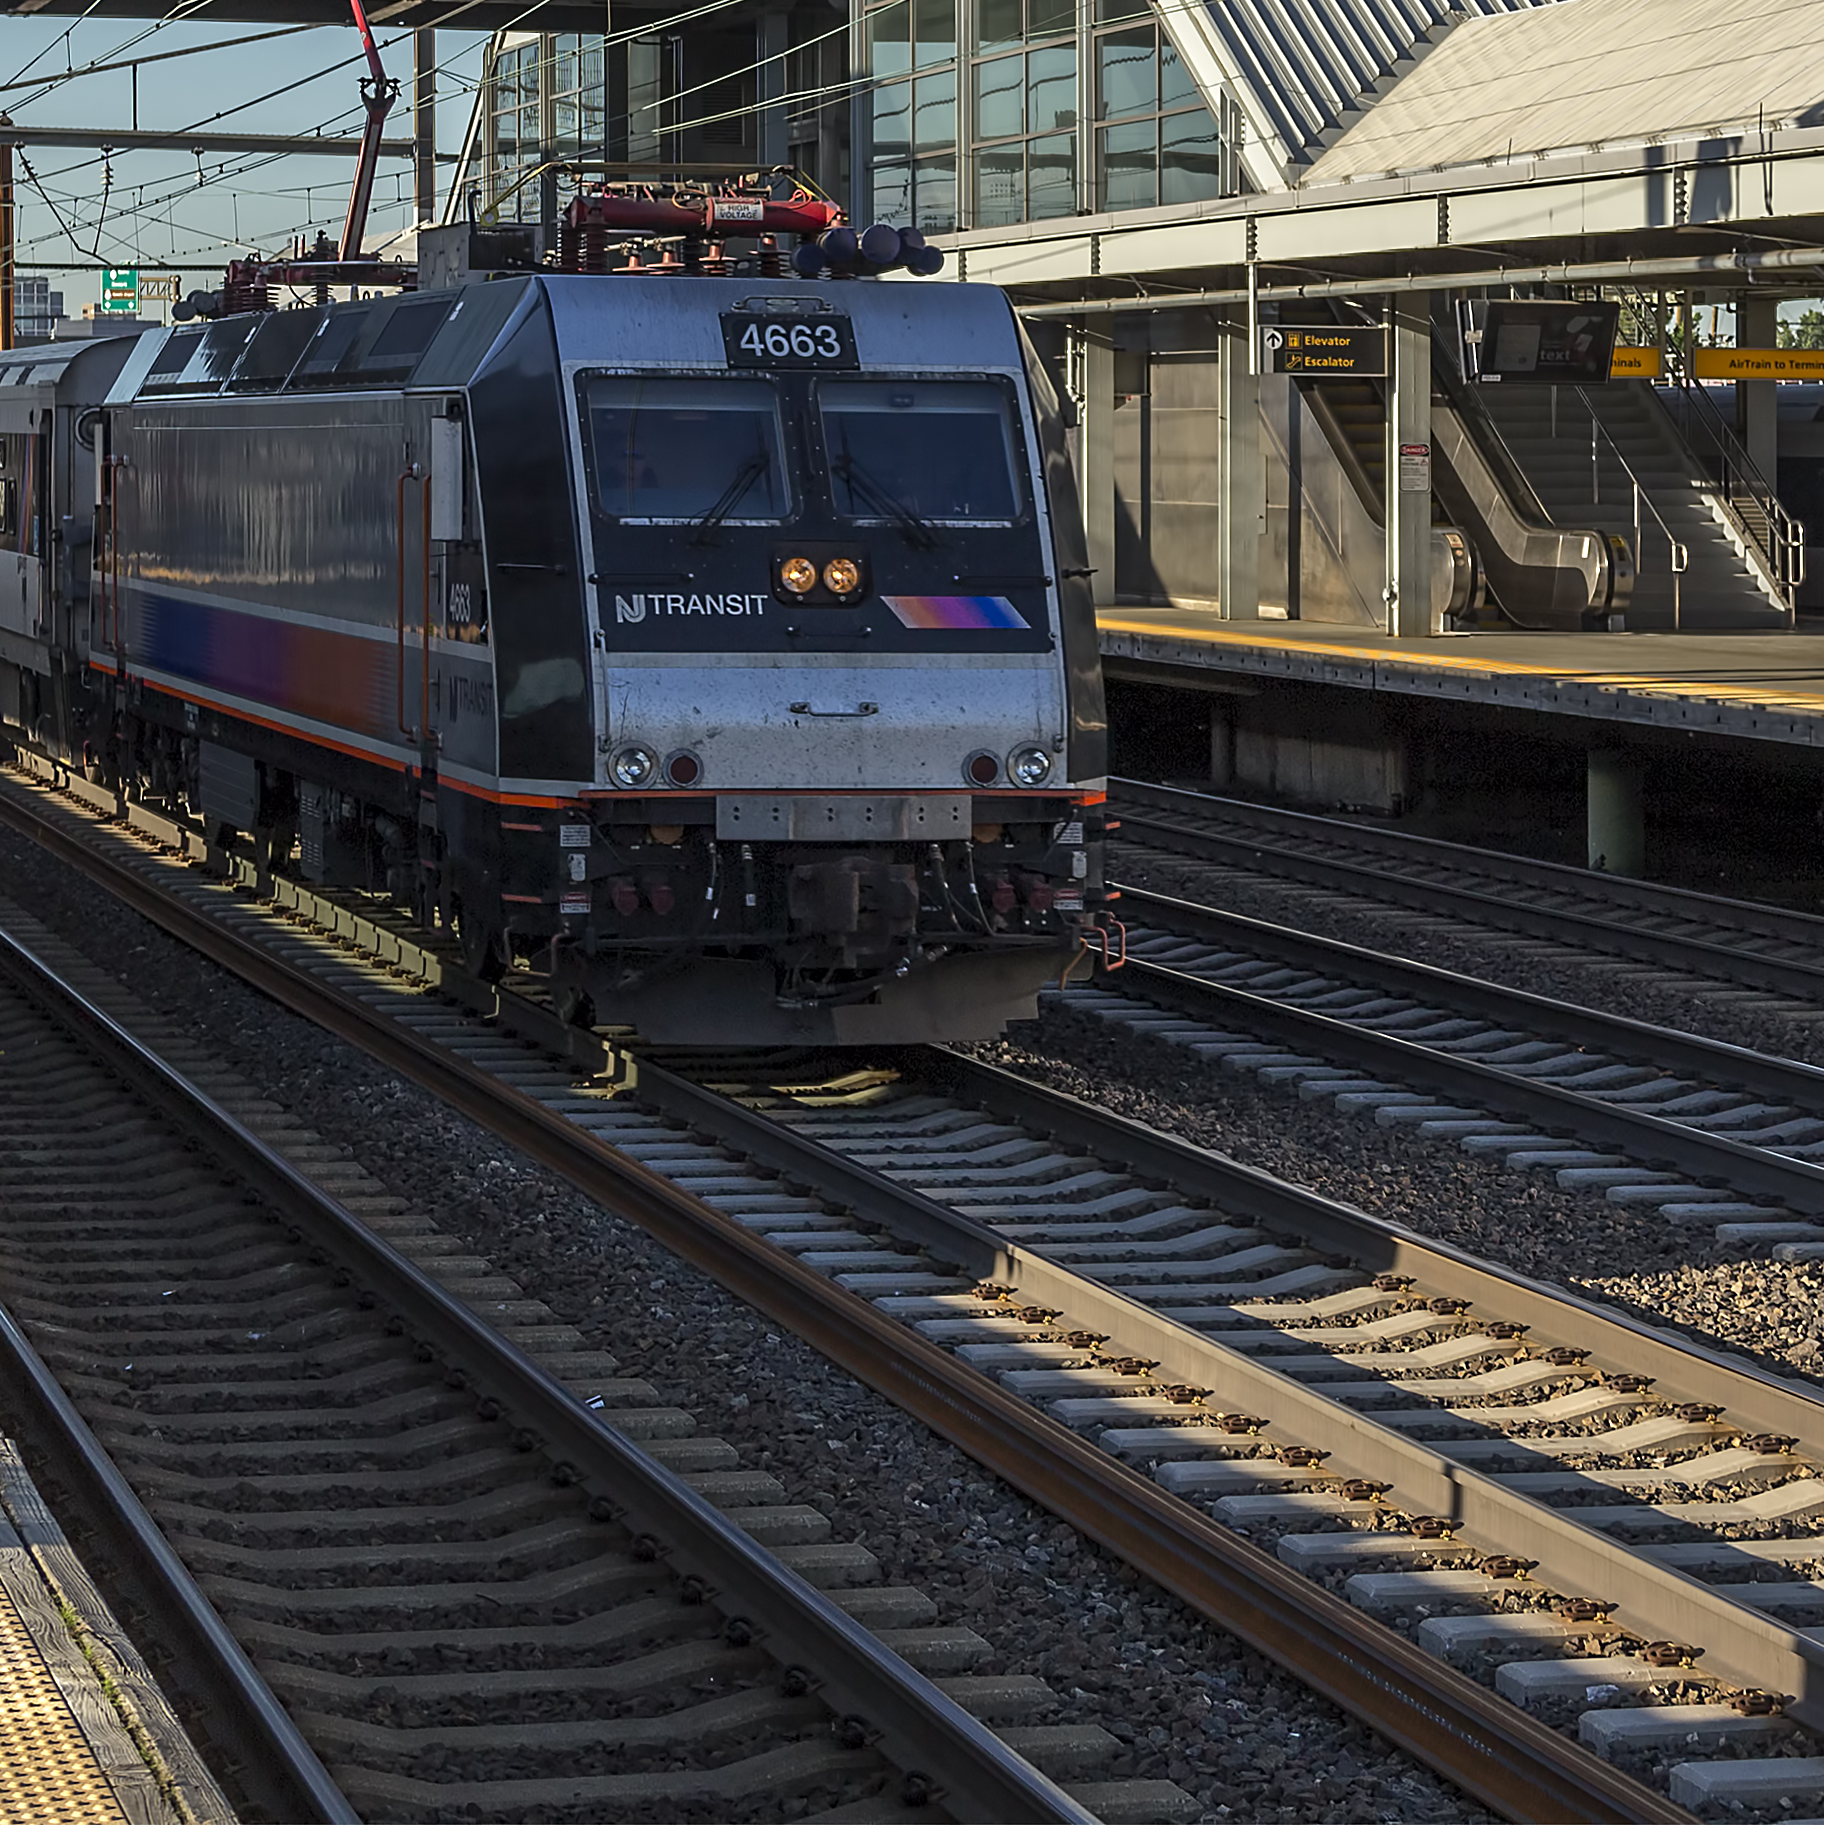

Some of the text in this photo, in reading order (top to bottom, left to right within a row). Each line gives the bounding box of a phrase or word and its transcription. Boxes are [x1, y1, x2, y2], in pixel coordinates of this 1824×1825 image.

[740, 323, 841, 357] 4663
[1304, 335, 1351, 346] Elevator
[1304, 356, 1355, 367] Escalator
[1540, 349, 1571, 362] text
[1729, 359, 1771, 369] AirTrain
[1776, 360, 1785, 369] to
[450, 584, 471, 622] 4663
[647, 594, 768, 615] TRANSIT
